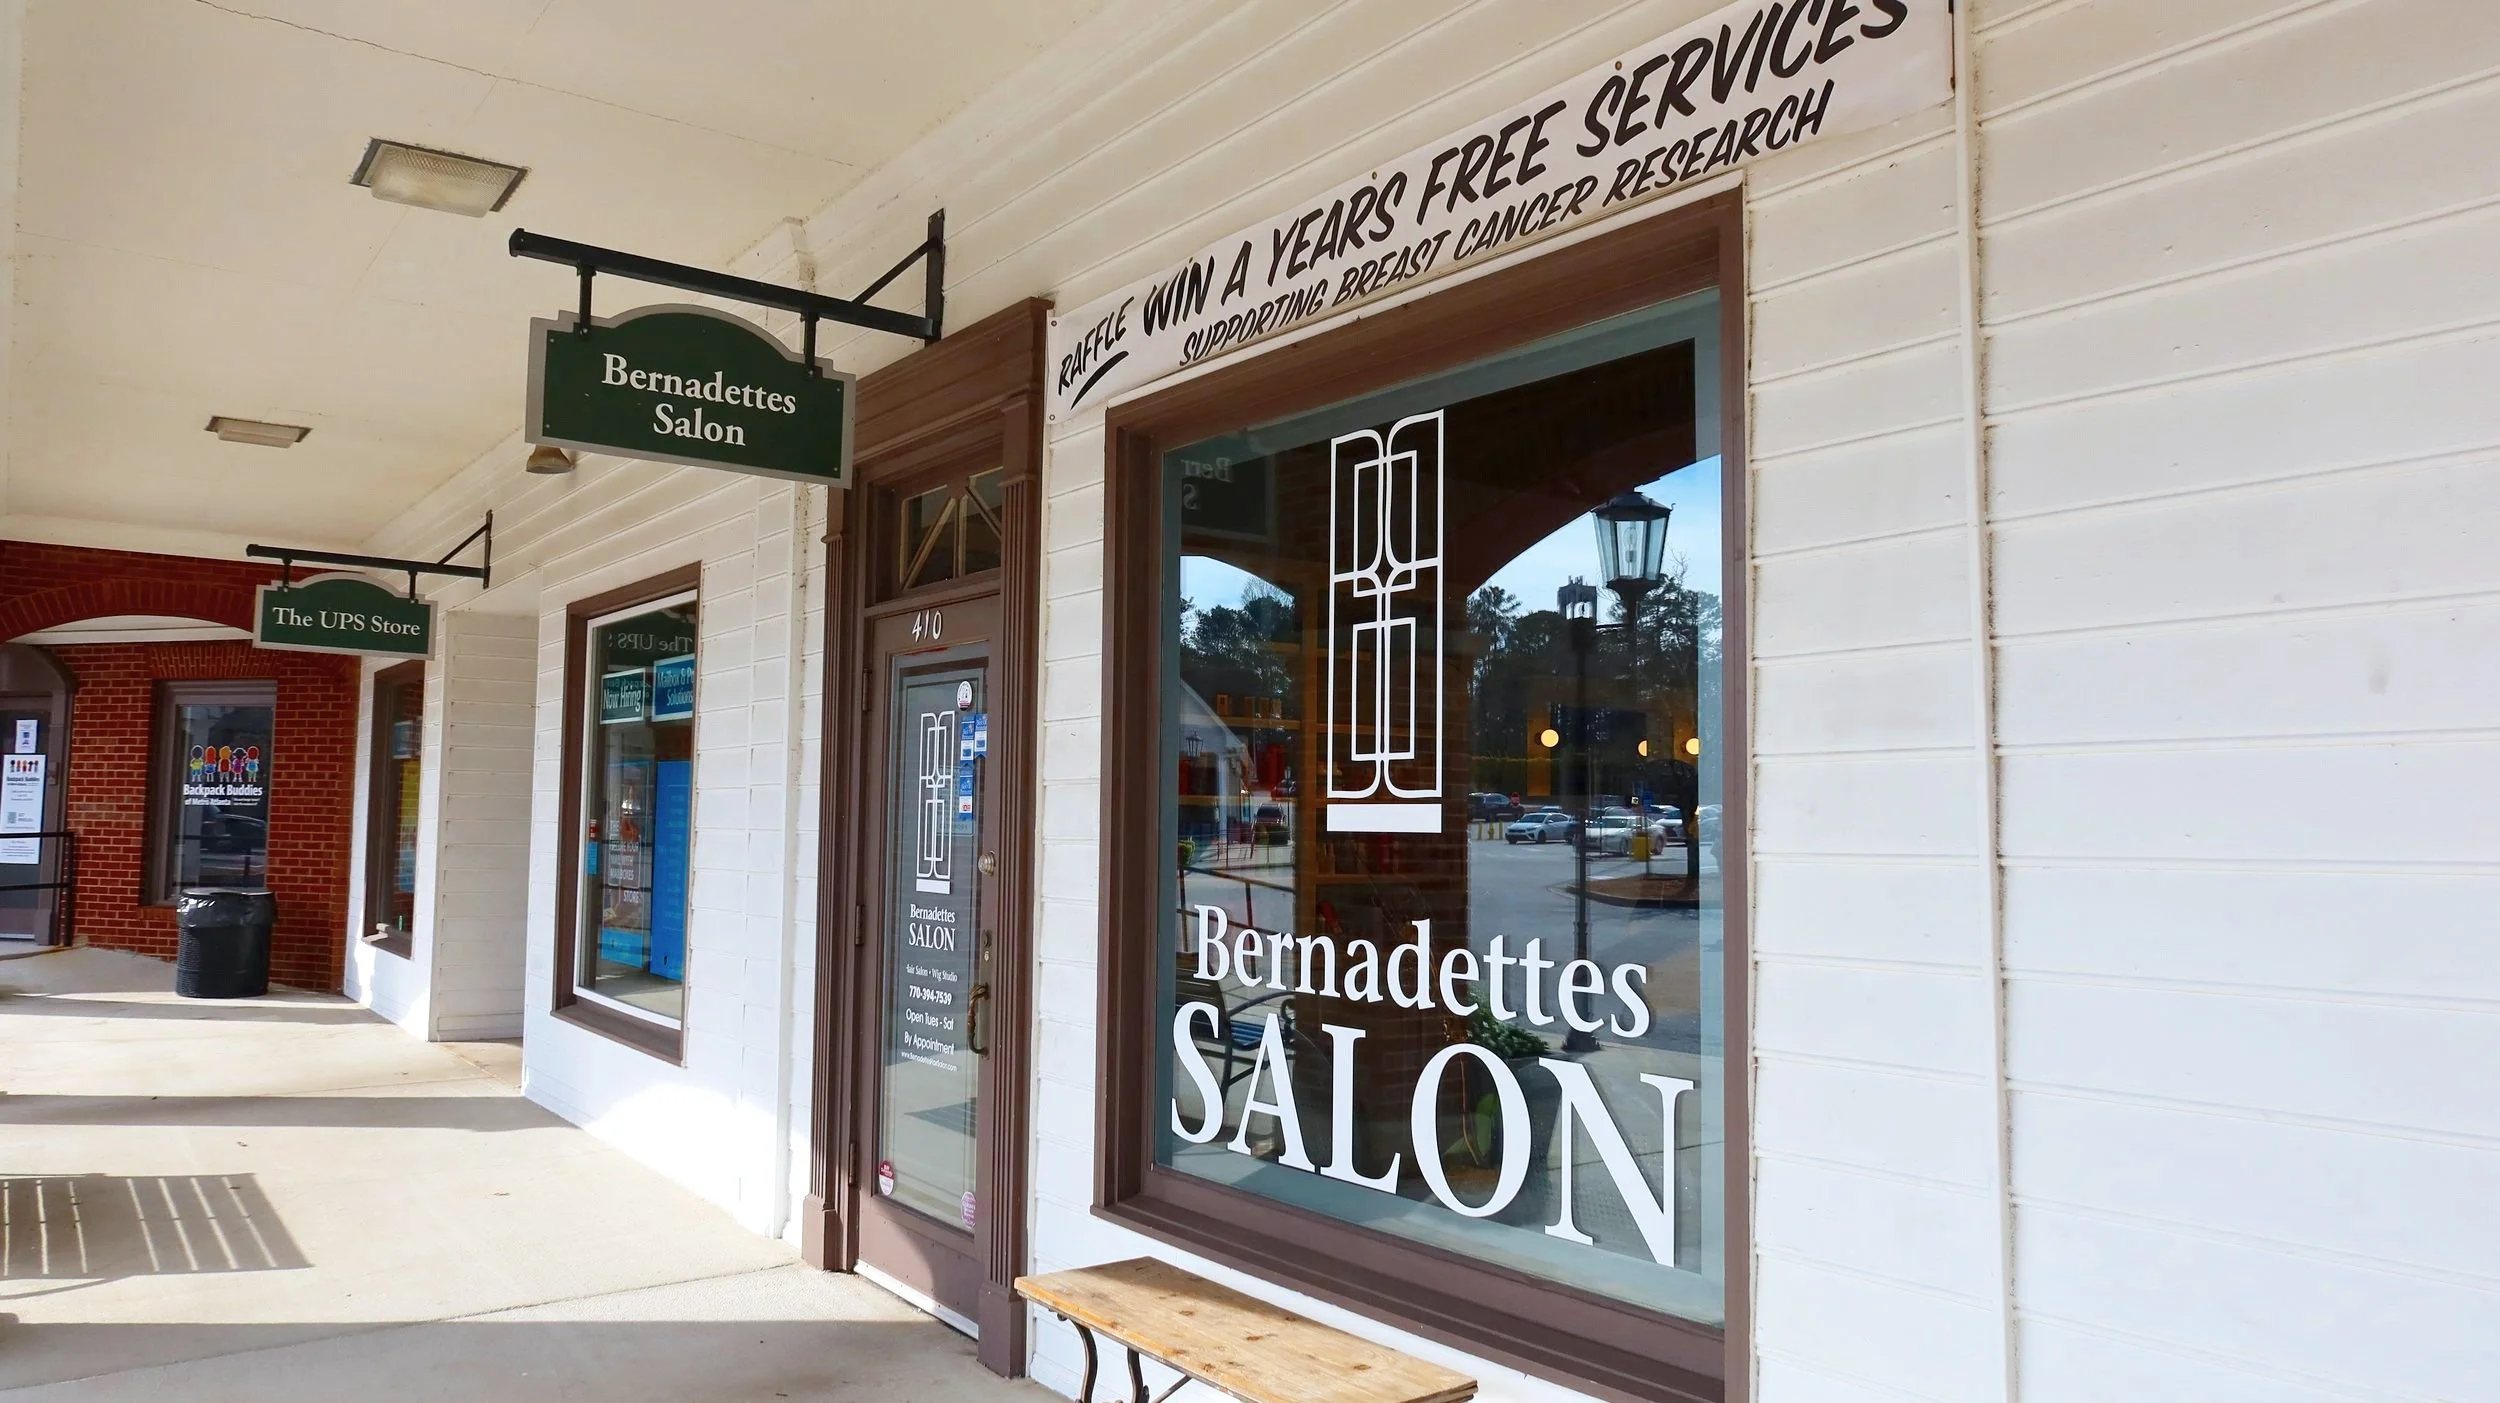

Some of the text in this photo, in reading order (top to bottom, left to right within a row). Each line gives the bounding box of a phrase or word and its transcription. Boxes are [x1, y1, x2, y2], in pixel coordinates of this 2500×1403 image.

[1179, 79, 1835, 367] SUPPORTING BREAST CANCER RESEARCH
[1058, 297, 1134, 396] RAFFLE
[1143, 255, 1215, 337] WIN
[1221, 240, 1252, 306] A
[1267, 171, 1408, 287] YEARS
[1416, 99, 1567, 226] FREE
[601, 352, 797, 415] Bernadettes
[653, 403, 746, 447] Salon
[272, 606, 421, 637] The UPS Store
[911, 609, 943, 643] 410
[603, 689, 620, 711] Now
[620, 684, 641, 713] Hiring
[183, 783, 263, 798] Backpack Buddies
[910, 903, 956, 924] Bernadettes
[908, 922, 956, 952] SALON
[915, 965, 928, 977] Salon
[932, 968, 942, 982] Wig
[942, 970, 958, 983] Studio
[1193, 904, 1649, 1039] Bernadettes
[909, 984, 952, 1006] 770-394-7539
[905, 1008, 924, 1024] Open
[925, 1012, 939, 1028] Tues
[943, 1016, 954, 1031] Sat
[904, 1031, 955, 1055] By Appointment
[1171, 1001, 1695, 1269] SALON
